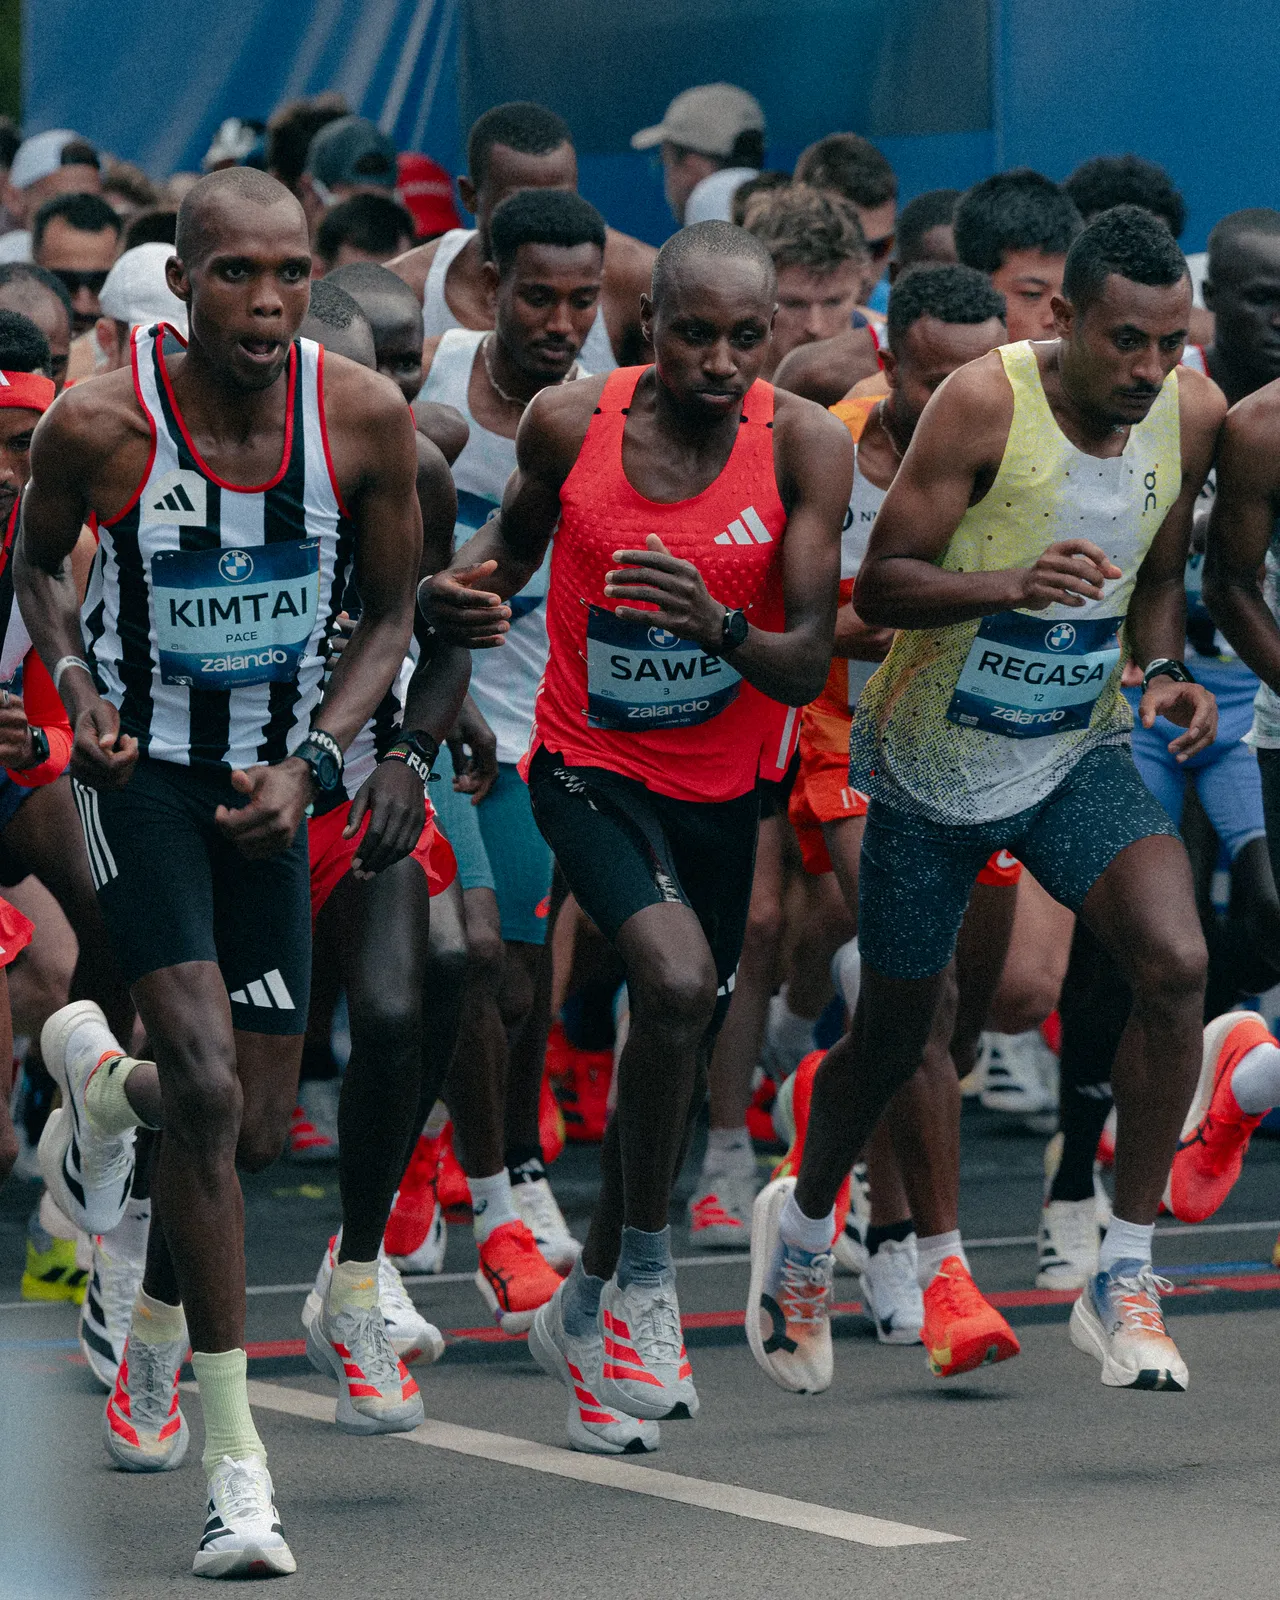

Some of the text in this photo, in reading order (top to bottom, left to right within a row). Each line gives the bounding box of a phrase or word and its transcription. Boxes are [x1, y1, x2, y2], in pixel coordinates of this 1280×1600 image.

[169, 587, 307, 628] KIMTAI
[226, 631, 258, 643] PACE
[201, 648, 288, 672] zalando
[610, 654, 722, 682] SAWE
[977, 650, 1105, 687] REGASA
[1033, 693, 1045, 702] 12
[627, 700, 710, 718] zalando
[990, 705, 1066, 725] zalando
